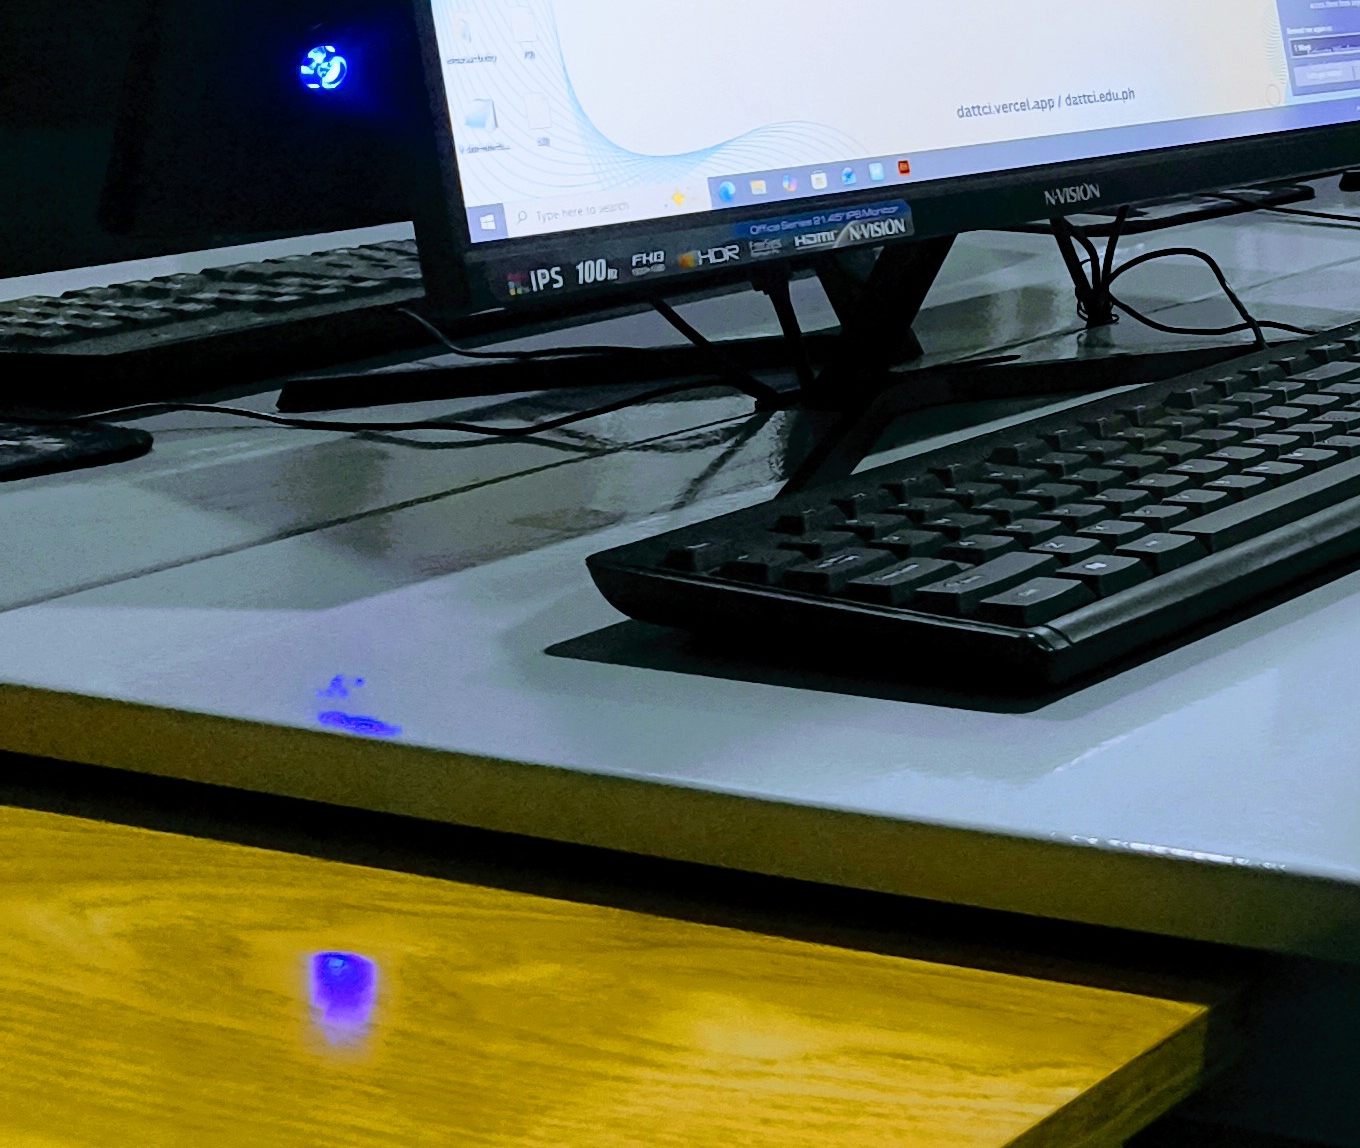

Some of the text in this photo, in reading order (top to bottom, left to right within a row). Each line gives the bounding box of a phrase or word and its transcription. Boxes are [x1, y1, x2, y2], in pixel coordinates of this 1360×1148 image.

[536, 210, 560, 225] Type
[562, 207, 583, 218] here
[631, 250, 665, 267] FHD
[697, 244, 740, 266] HDR
[530, 266, 564, 292] IPS
